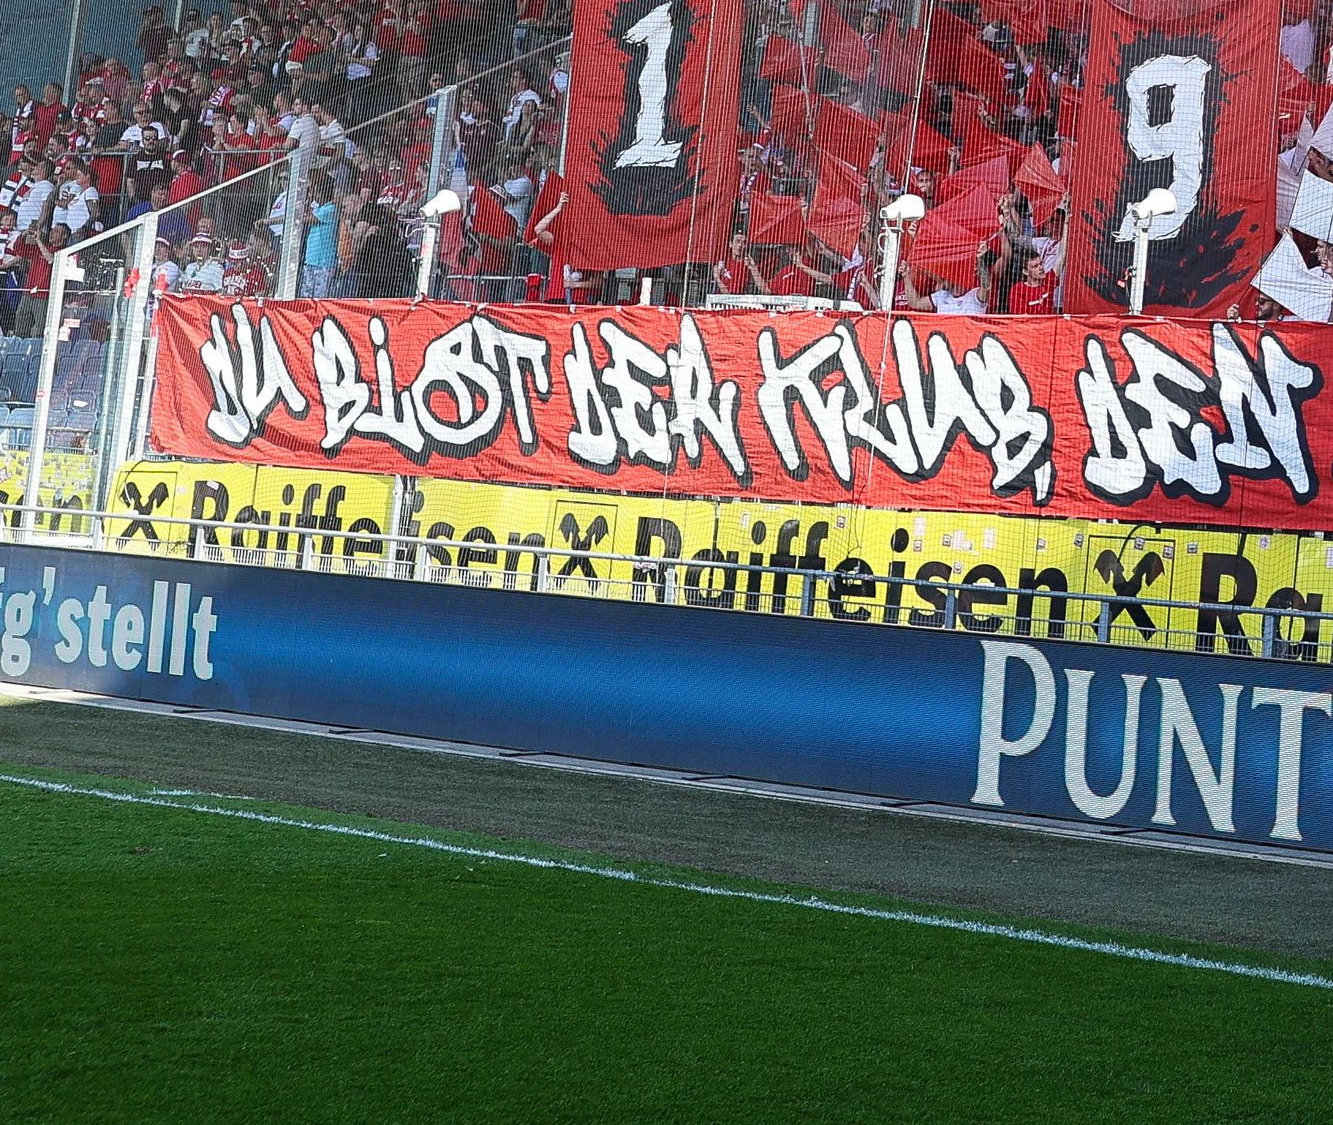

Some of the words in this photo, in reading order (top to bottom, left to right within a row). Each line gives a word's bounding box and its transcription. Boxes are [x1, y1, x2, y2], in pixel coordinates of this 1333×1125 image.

[614, 0, 685, 169] 1
[1113, 54, 1213, 243] 9
[187, 479, 544, 592] Raiffeisen
[630, 515, 1070, 643] Raiffeisen
